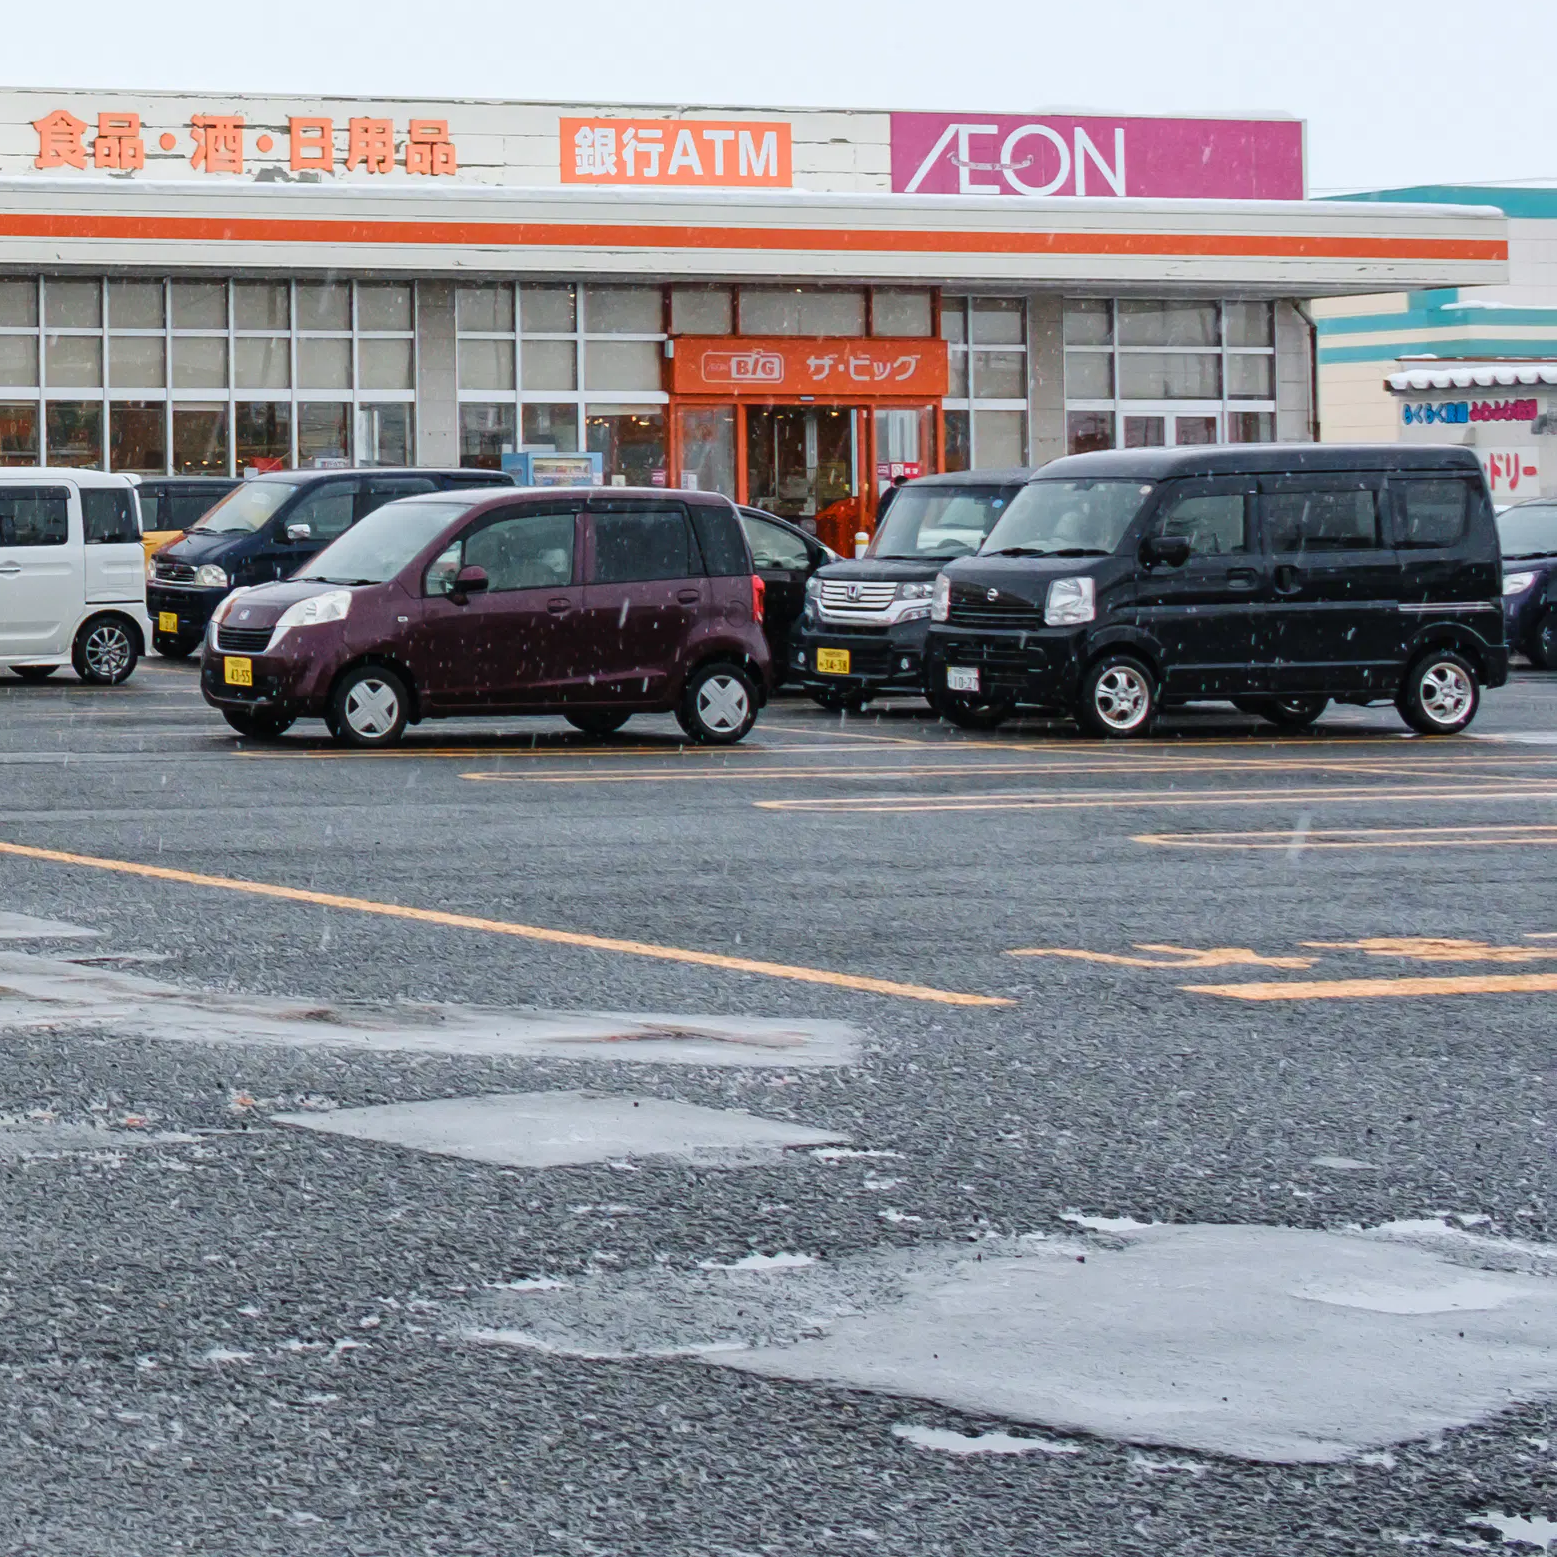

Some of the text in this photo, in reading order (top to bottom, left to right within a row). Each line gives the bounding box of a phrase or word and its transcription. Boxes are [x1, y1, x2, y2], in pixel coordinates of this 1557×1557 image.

[33, 110, 458, 175] 食品・酒・日用品
[574, 126, 778, 179] 銀行ATM
[806, 354, 922, 381] ザ・ビッグ
[1483, 452, 1538, 491] ドリー
